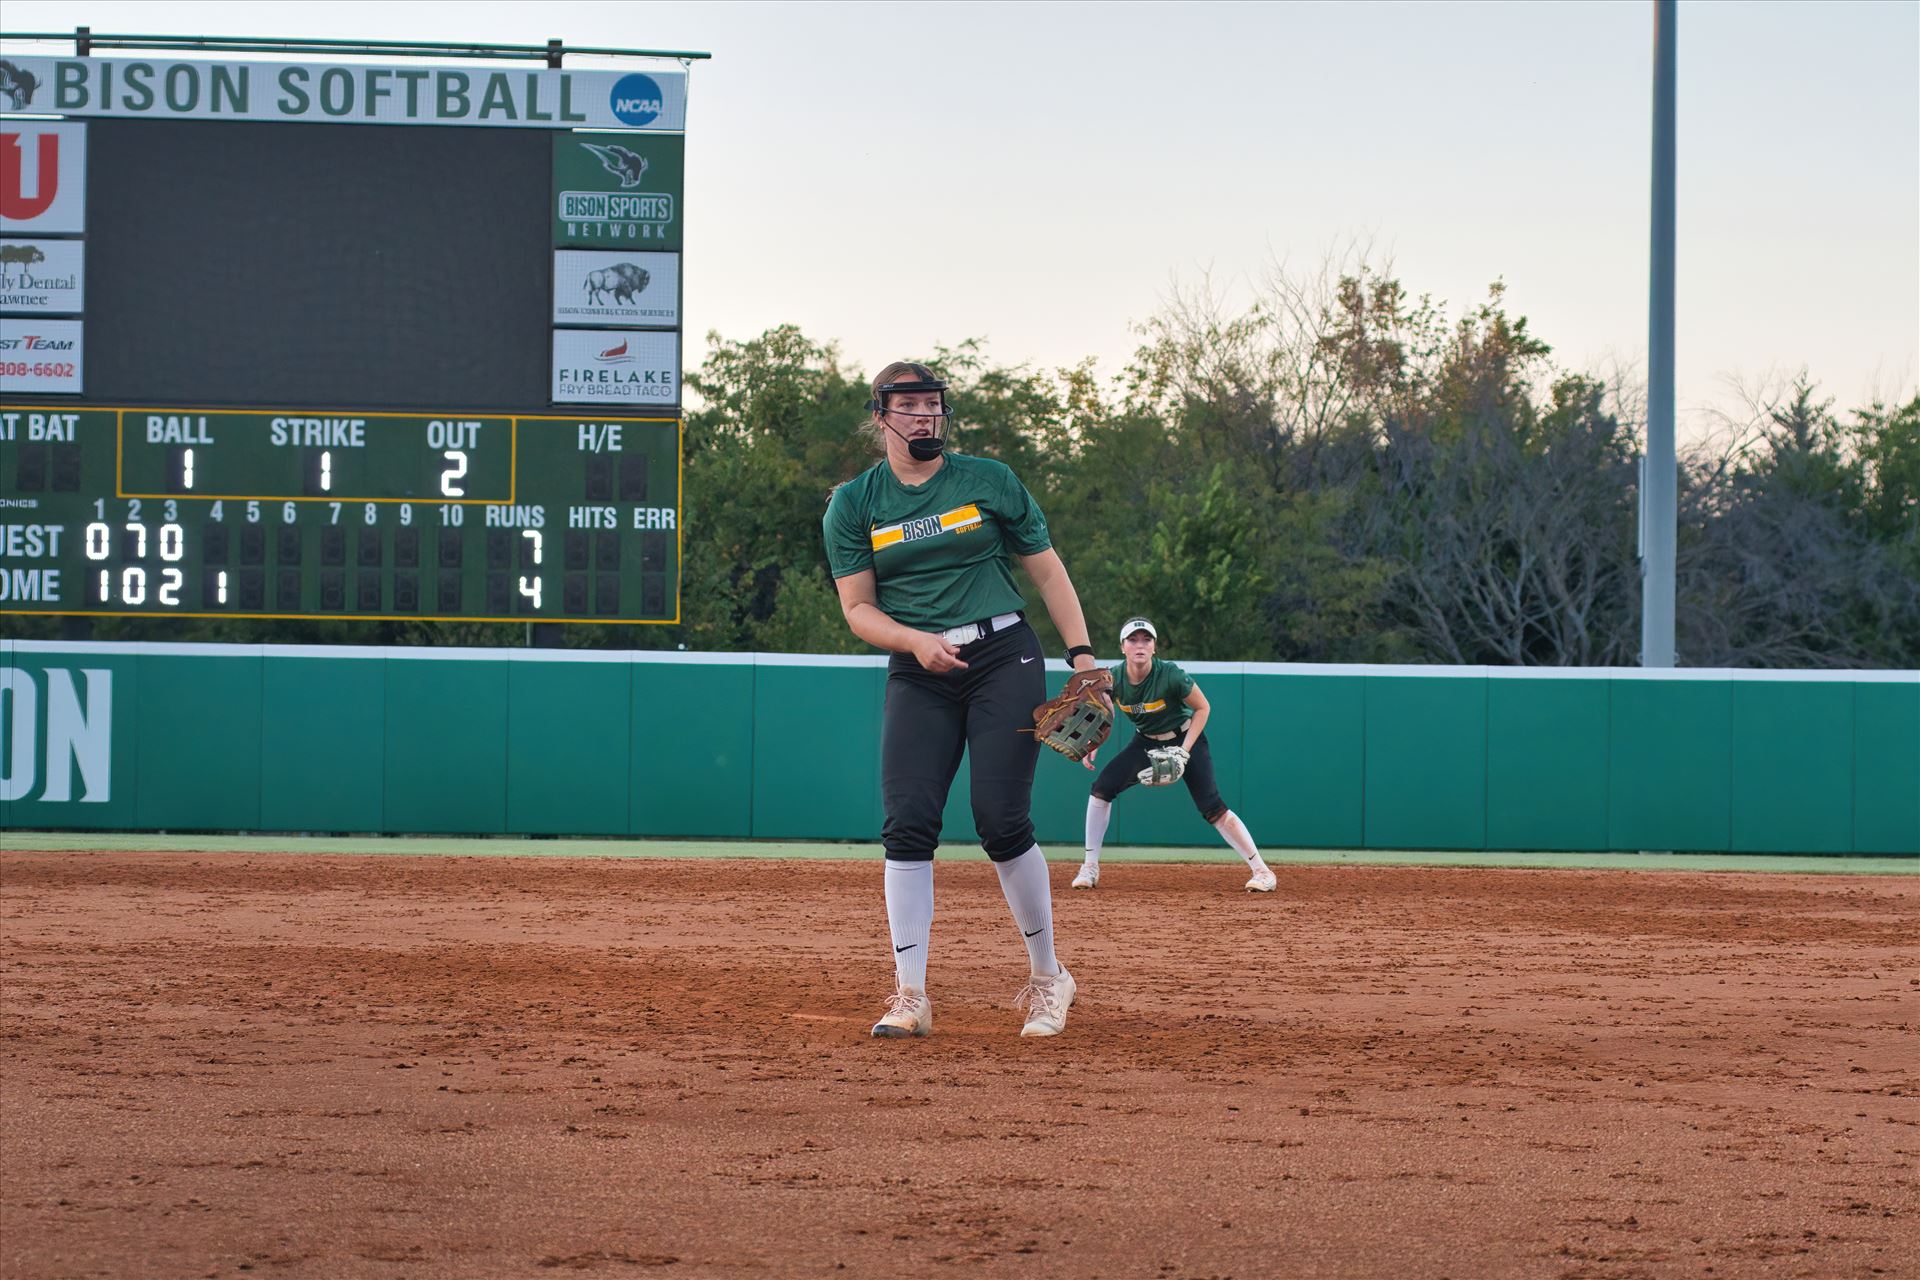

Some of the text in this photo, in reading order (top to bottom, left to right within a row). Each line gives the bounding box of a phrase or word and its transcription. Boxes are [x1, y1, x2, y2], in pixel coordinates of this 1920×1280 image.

[55, 61, 587, 122] BISON SOFTBALL
[616, 98, 663, 113] NCAA
[565, 196, 667, 219] BISON SPORTS
[567, 223, 665, 238] NETWORK
[19, 273, 76, 290] Dental
[559, 369, 672, 384] FIRELAKE
[559, 384, 672, 397] FRY BREAD TACO
[28, 414, 81, 441] BAT
[146, 416, 215, 444] BALL
[270, 418, 365, 447] STRIKE
[427, 420, 481, 449] OUT
[578, 424, 622, 453] H/E
[183, 448, 194, 489] 1
[320, 451, 331, 491] 1
[441, 451, 467, 497] 2
[93, 498, 676, 530] 1 2 3 4 5 6 7 8 9 10 RUNS HITS ERR
[902, 515, 942, 542] BISON
[86, 522, 542, 564] 0 7 0 7
[0, 568, 61, 602] OME
[100, 567, 542, 609] 1 0 2 1 4
[0, 667, 112, 803] ON
